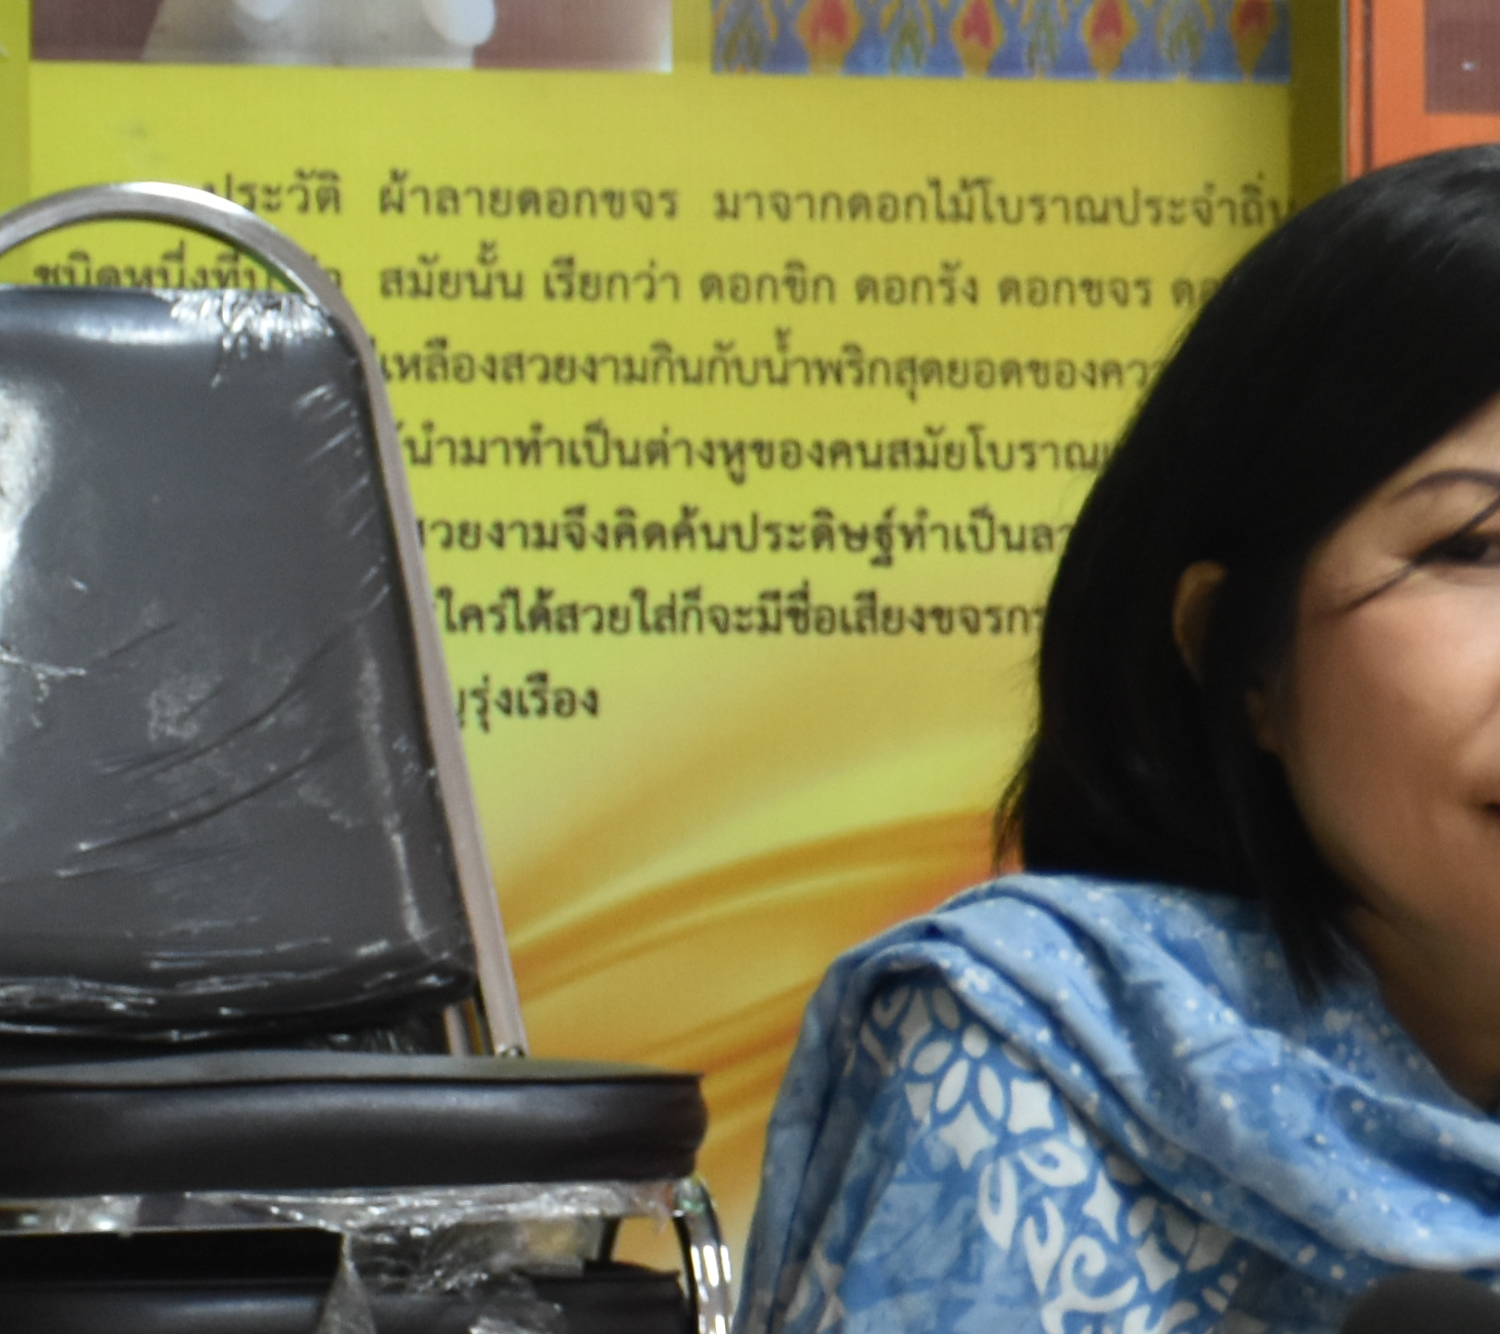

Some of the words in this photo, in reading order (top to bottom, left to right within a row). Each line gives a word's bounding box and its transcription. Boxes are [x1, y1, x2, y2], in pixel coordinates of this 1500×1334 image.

[379, 171, 679, 218] ผ้าลายดอกขจร
[380, 240, 524, 300] สมัยนั้น
[543, 256, 681, 302] เรียกว่า
[855, 262, 979, 308] ดอกรัง
[999, 273, 1153, 309] ดอกขจร
[455, 672, 600, 730] รุ่งเรือง
